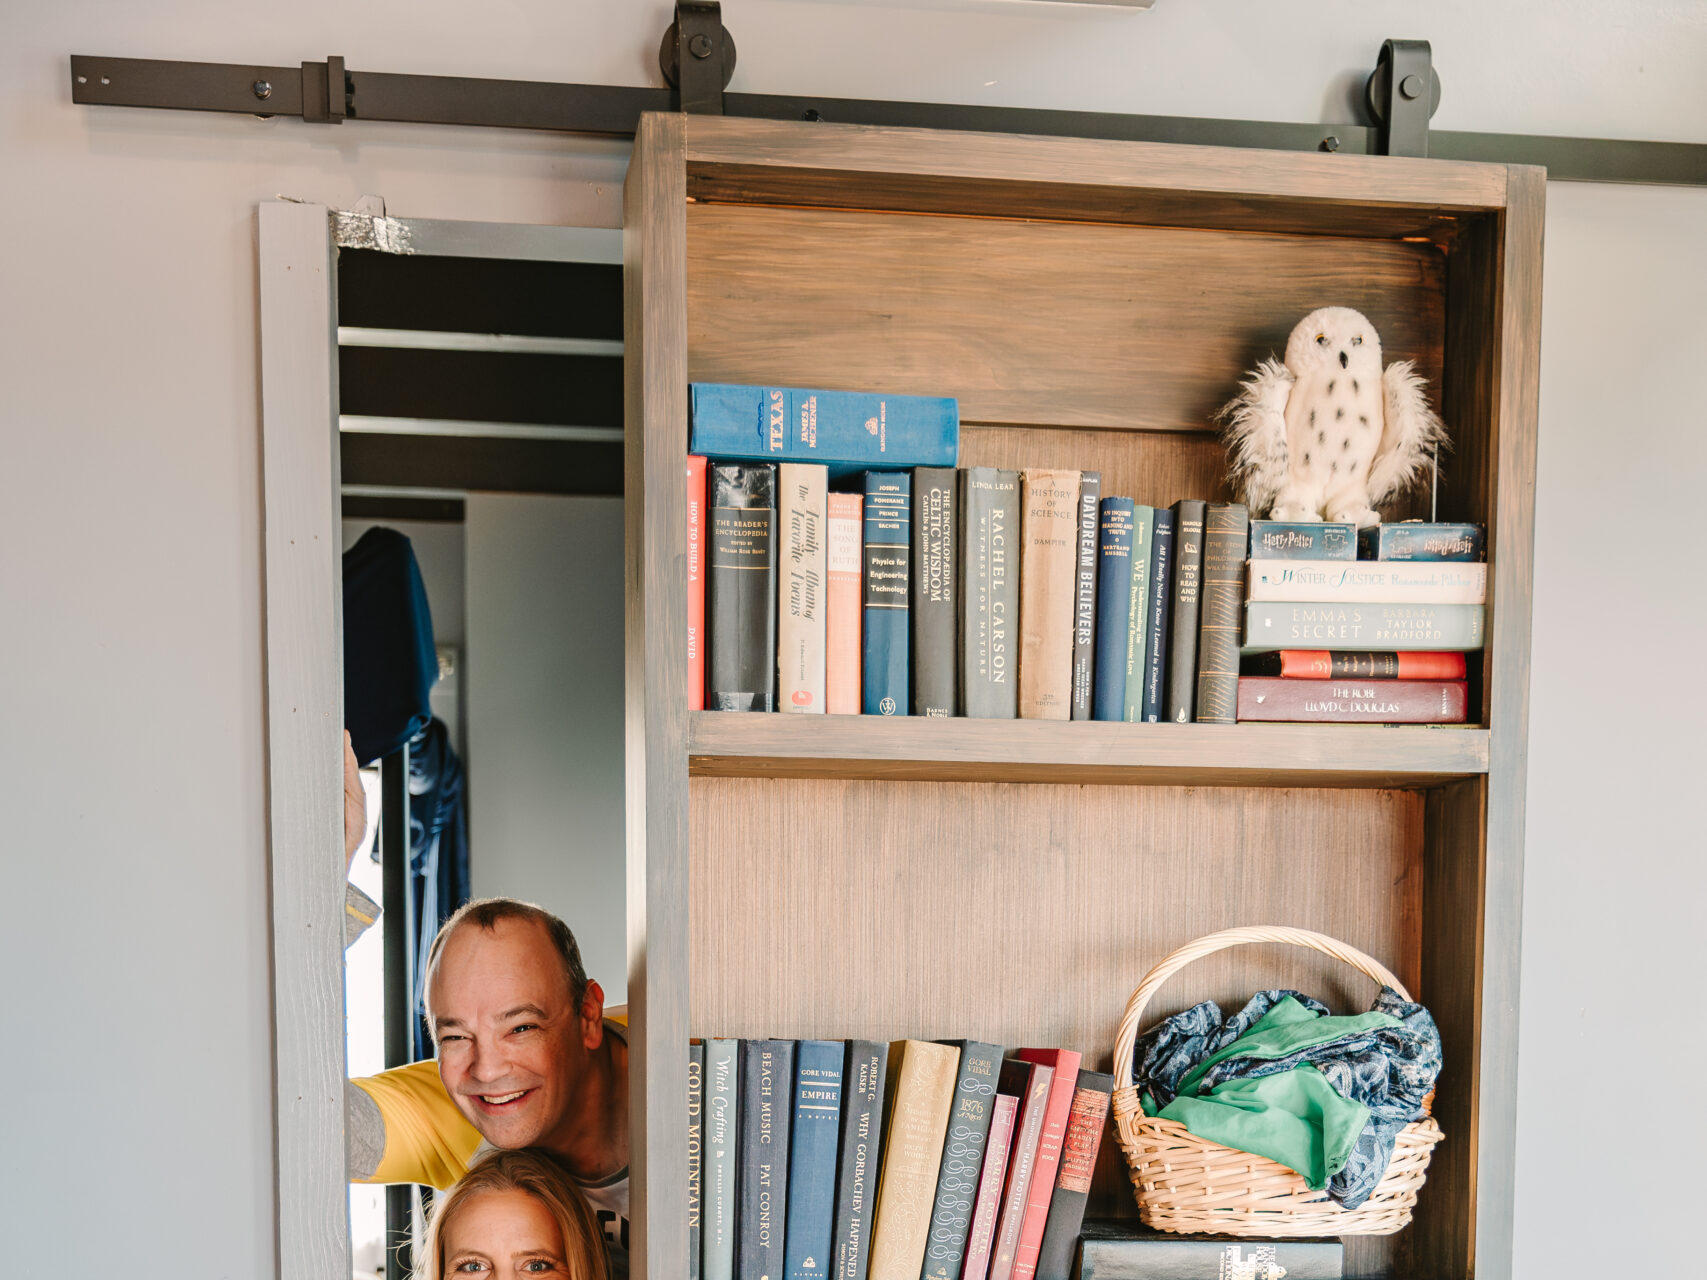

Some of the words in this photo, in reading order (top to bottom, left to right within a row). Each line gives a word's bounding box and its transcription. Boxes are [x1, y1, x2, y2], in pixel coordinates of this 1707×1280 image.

[770, 390, 784, 452] TEXAS
[801, 410, 809, 443] JAMES
[809, 395, 817, 448] MICHENER
[971, 482, 993, 490] LINDA
[995, 482, 1014, 490] LEAR
[1031, 489, 1072, 498] HISTORY
[943, 489, 951, 509] THE
[690, 501, 698, 524] HOW
[715, 519, 730, 527] THE
[733, 520, 768, 528] READER'S
[930, 488, 941, 538] CELTIC
[1031, 509, 1072, 520] SCIENCE
[690, 527, 698, 540] TO
[715, 528, 768, 537] ENCYCLOPEDIA
[791, 509, 805, 563] Favorite
[805, 509, 820, 556] Family
[1081, 495, 1096, 567] DAYDREAM
[1263, 532, 1288, 551] Harry
[1288, 531, 1314, 549] Potter
[690, 543, 698, 573] BUILD
[992, 508, 1005, 590] RACHEL
[1159, 544, 1167, 556] All
[871, 557, 895, 567] Physics
[930, 540, 941, 602] WISDOM
[1133, 560, 1145, 582] WE
[1156, 561, 1165, 583] Really
[870, 571, 908, 581] Engineering
[1329, 568, 1385, 588] SOLSTICE
[791, 571, 805, 616] Poems
[805, 569, 819, 610] Album
[870, 584, 907, 595] Technology
[943, 589, 951, 602] OF
[1078, 572, 1093, 646] BELIEVERS
[1136, 586, 1145, 632] Understanding
[1383, 608, 1436, 618] BARBARA
[1291, 625, 1362, 639] SECRET
[1376, 630, 1441, 640] BRADFORD
[1387, 619, 1432, 629] TAYLOR
[688, 627, 696, 659] DAVID
[992, 601, 1005, 684] CARSON
[1153, 632, 1161, 658] Learned
[1150, 666, 1159, 704] Kindergarten
[1333, 687, 1350, 697] THE
[1352, 688, 1376, 698] ROBE
[1305, 701, 1338, 712] LLOYD
[1350, 702, 1400, 713] DOUGLAS
[716, 1055, 731, 1092] Witch
[761, 1052, 772, 1096] BEACH
[801, 1069, 820, 1077] GORE
[821, 1070, 840, 1078] VIDAL
[868, 1056, 879, 1092] ROBERT
[967, 1065, 992, 1076] VIDAL
[968, 1057, 992, 1068] GORE
[688, 1062, 701, 1116] COLD
[858, 1063, 868, 1094] KAISER
[801, 1090, 837, 1100] EMPIRE
[960, 1098, 984, 1113] 1876
[711, 1096, 728, 1144] Crafting
[760, 1102, 771, 1144] MUSIC
[858, 1112, 870, 1140] WHY
[1070, 1126, 1099, 1136] LIFETIME
[1080, 1119, 1093, 1127] THE
[1069, 1133, 1097, 1143] READING
[1073, 1141, 1089, 1149] PLAN
[990, 1144, 1006, 1195] HARRY
[1020, 1152, 1030, 1178] HARRY
[1066, 1157, 1089, 1165] CLIFTON
[688, 1124, 700, 1227] MOUNTAIN
[760, 1164, 771, 1187] PAT
[852, 1143, 867, 1214] GORBACHEV
[1012, 1179, 1024, 1211] POTTER
[759, 1192, 770, 1248] CONROY
[978, 1201, 995, 1255] POTTER
[847, 1218, 861, 1278] HAPPENED
